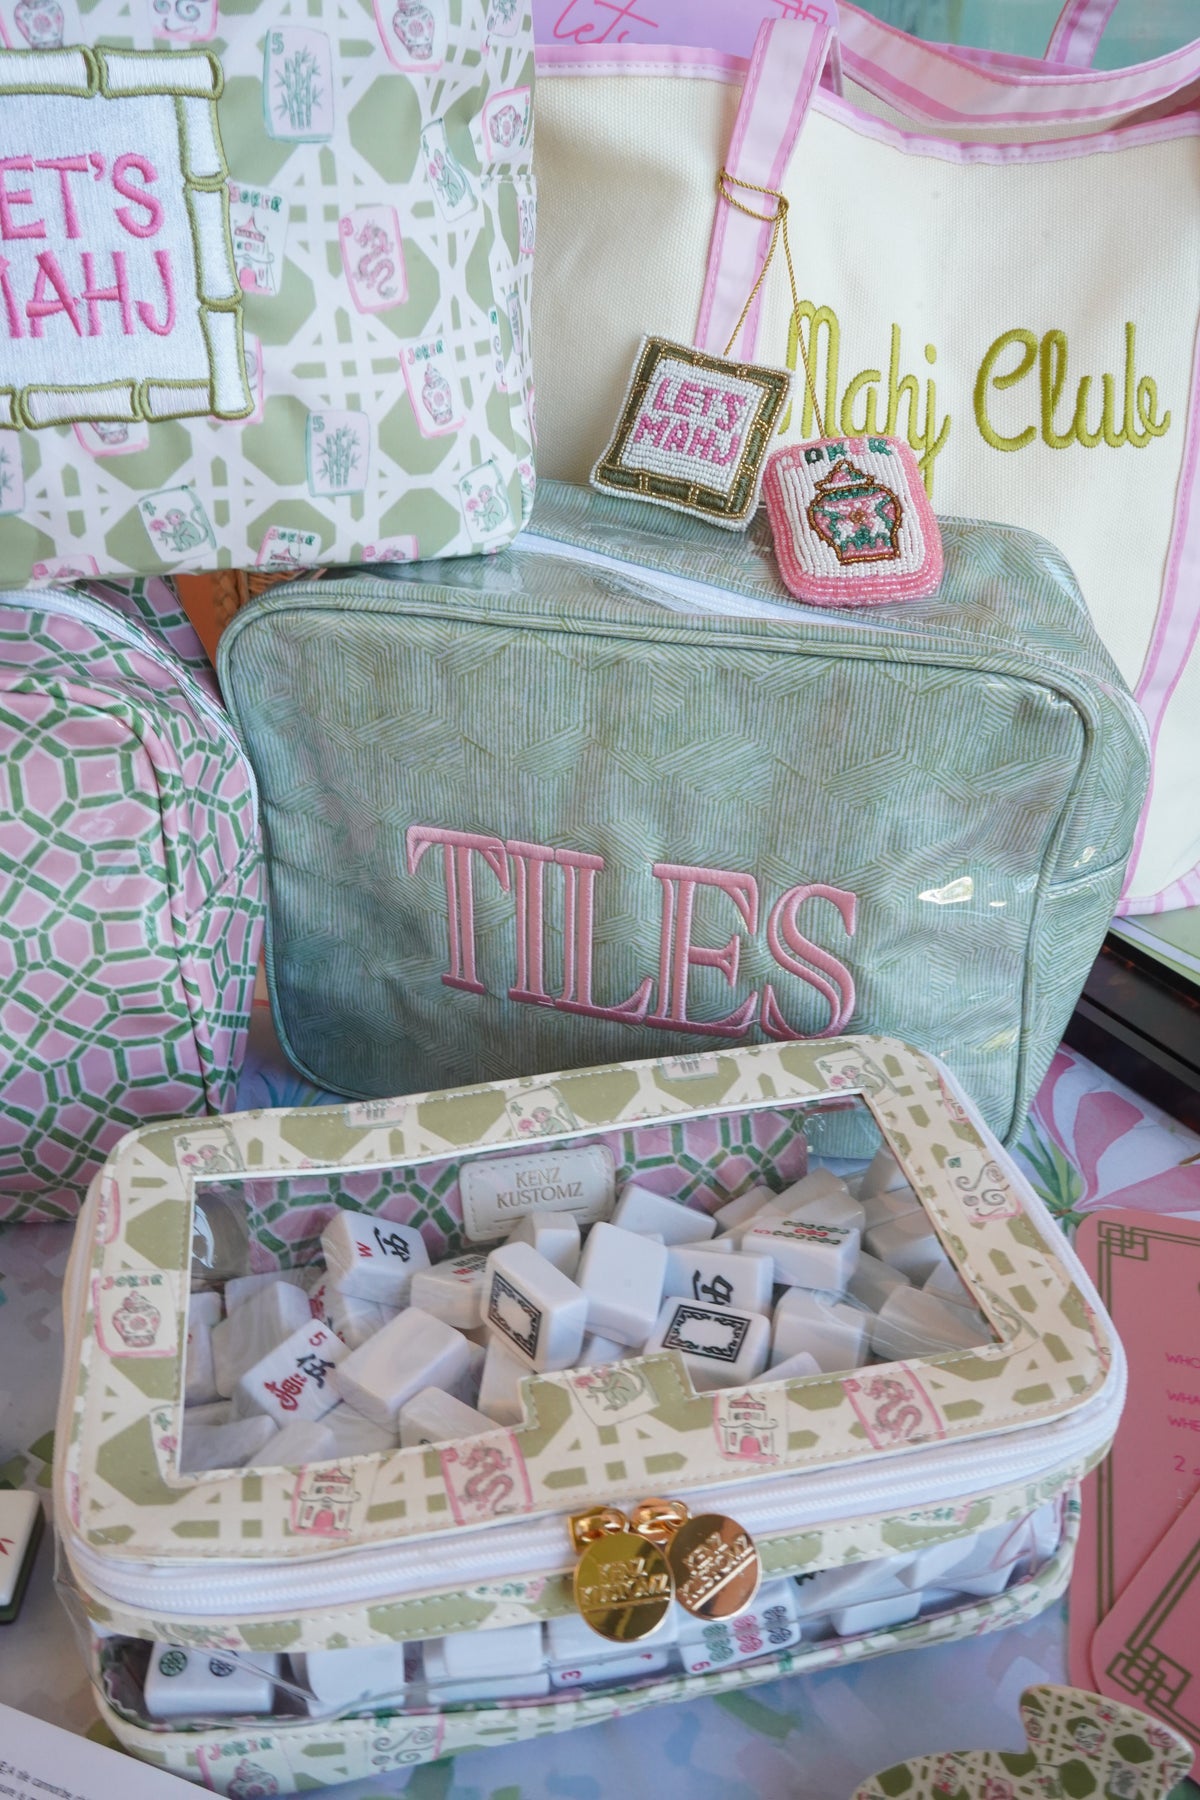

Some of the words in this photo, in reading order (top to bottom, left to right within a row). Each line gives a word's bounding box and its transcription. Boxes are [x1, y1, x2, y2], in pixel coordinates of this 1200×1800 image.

[272, 32, 285, 55] 5
[777, 299, 951, 500] Mahj
[973, 321, 1172, 452] Club
[633, 413, 740, 467] MAHJ
[406, 825, 857, 1040] TILES
[515, 1167, 561, 1188] KENZ
[496, 1181, 584, 1209] KUSTOMZ
[309, 1331, 328, 1347] 5
[1173, 1454, 1186, 1473] 2
